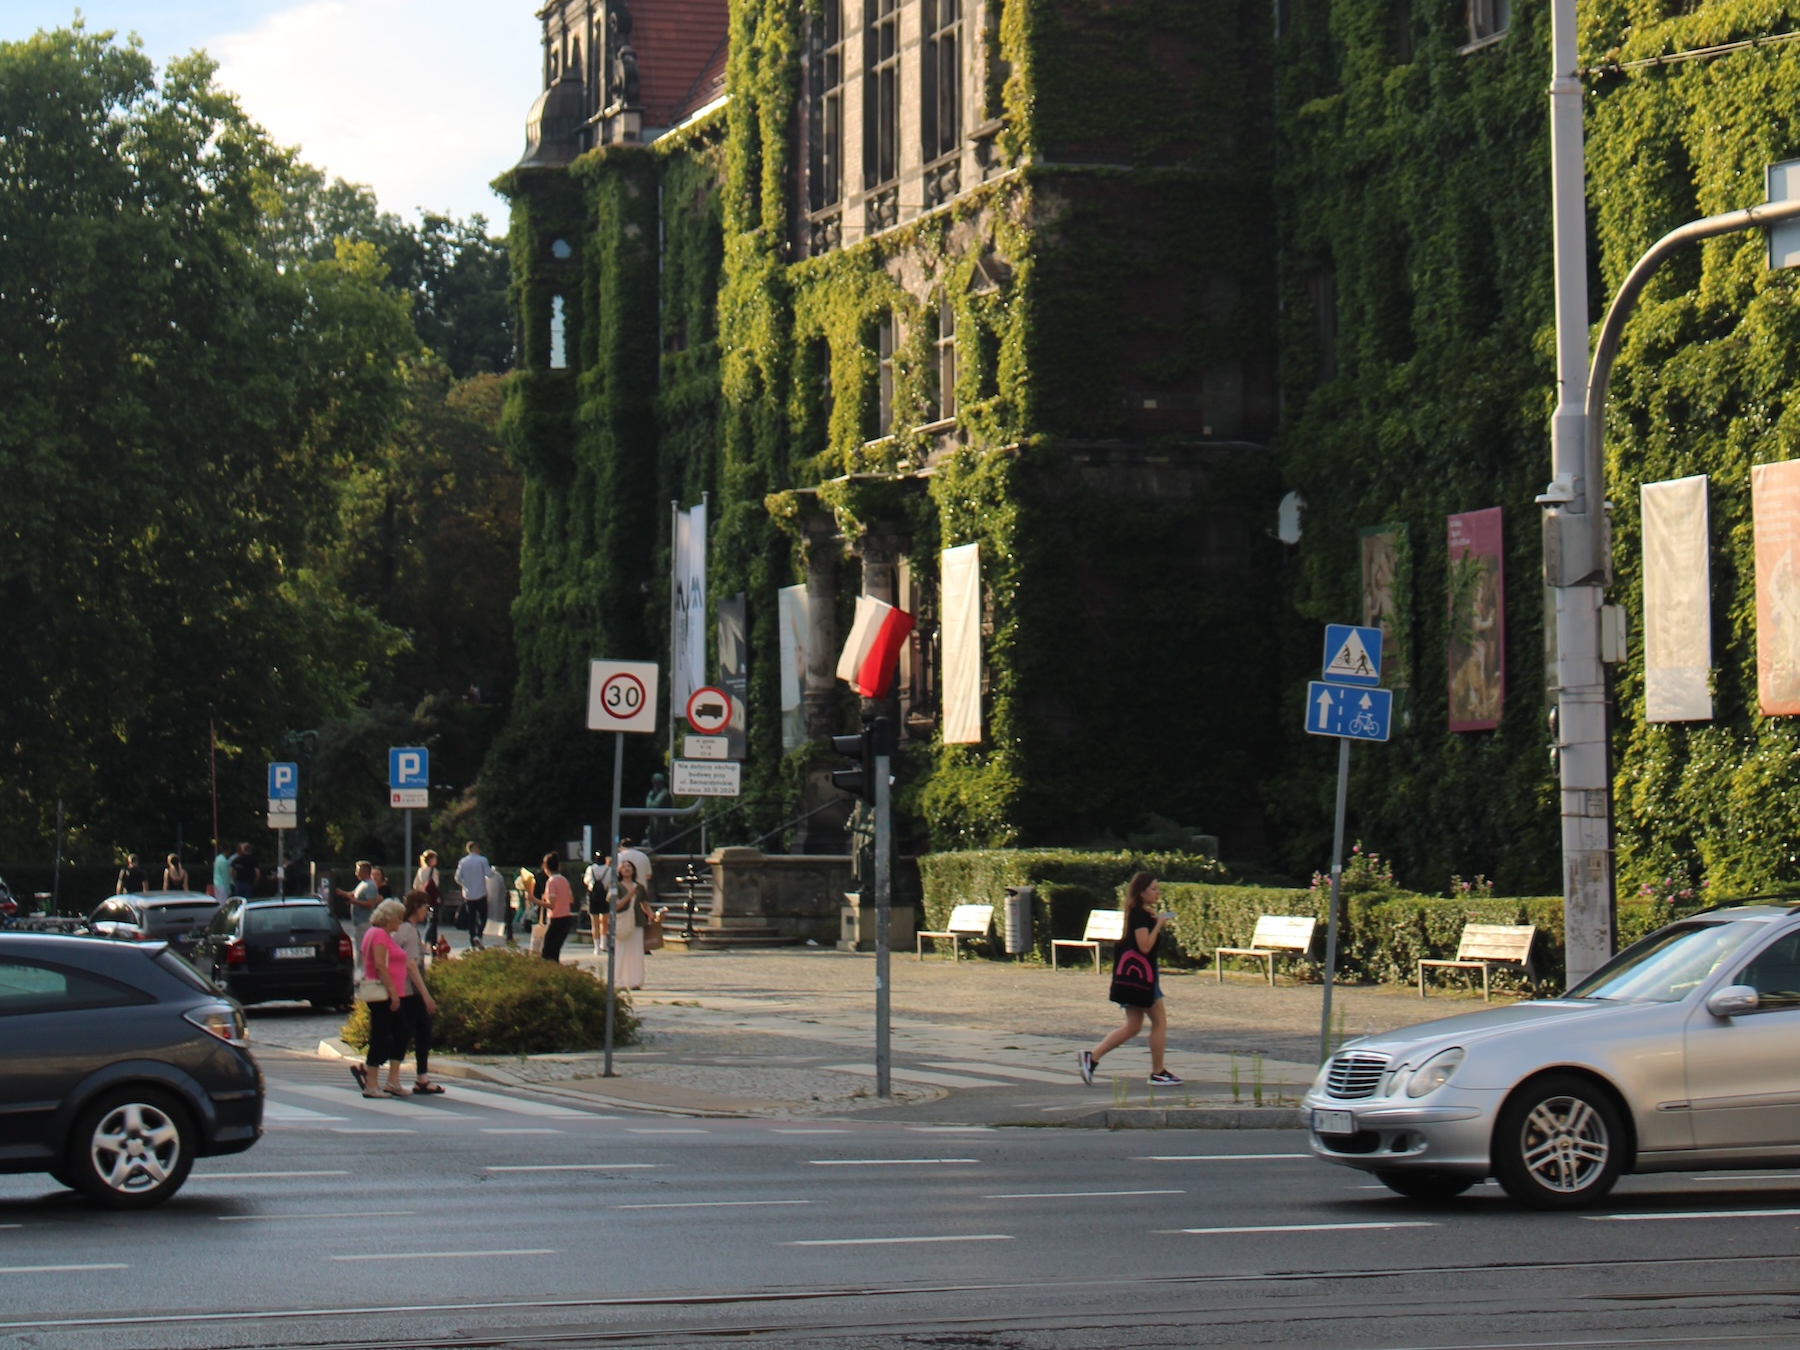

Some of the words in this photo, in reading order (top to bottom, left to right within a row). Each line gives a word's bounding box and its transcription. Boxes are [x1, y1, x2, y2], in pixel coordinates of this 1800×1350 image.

[607, 684, 640, 708] 30
[275, 766, 291, 789] P
[399, 753, 420, 784] P
